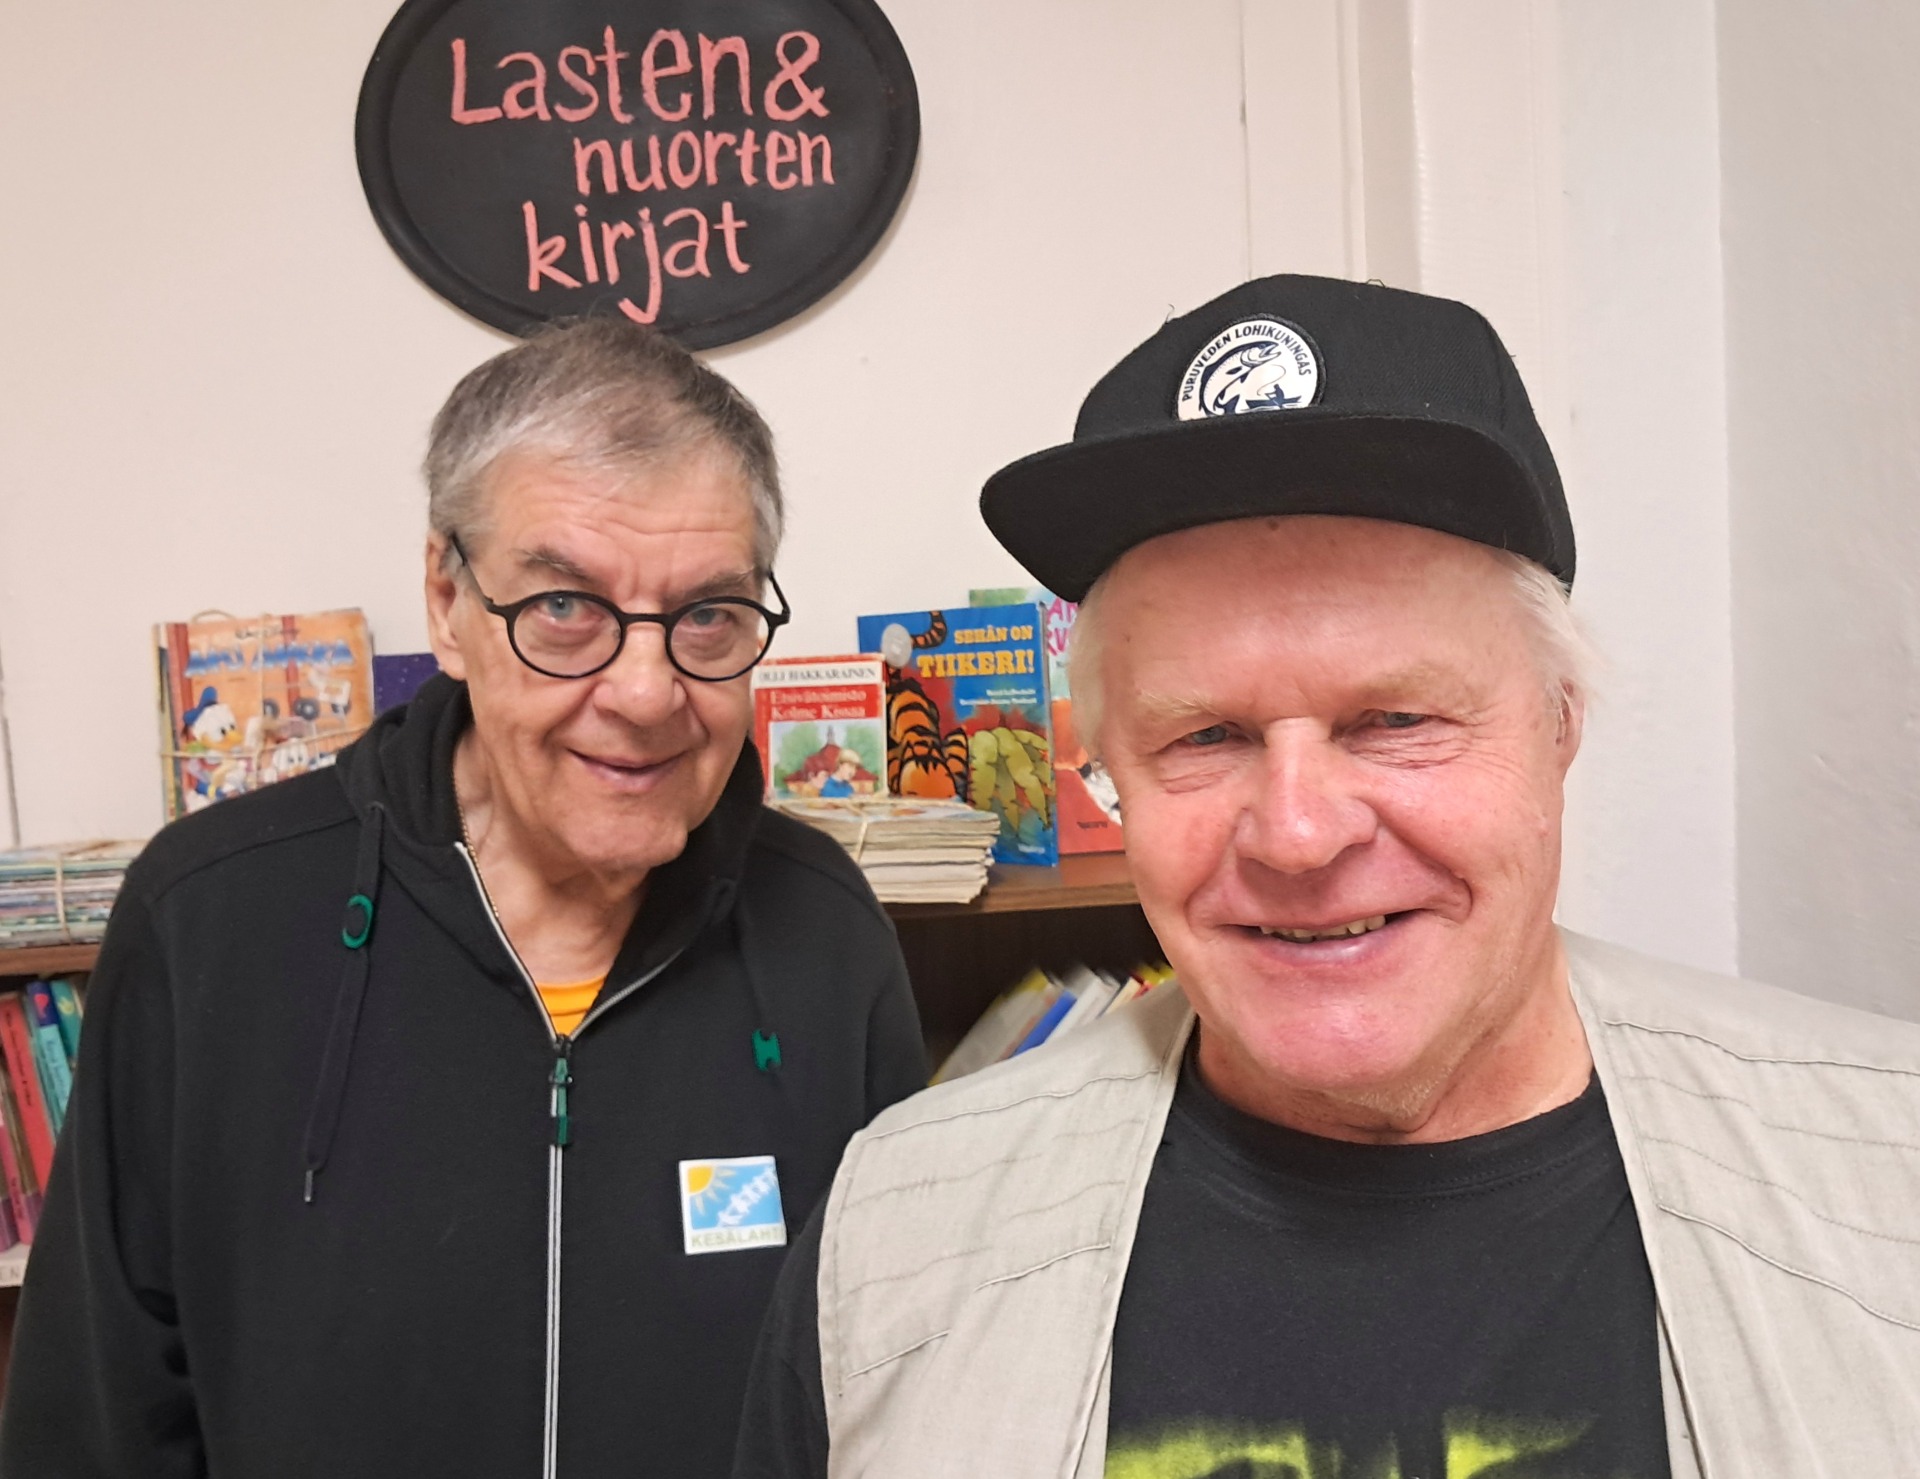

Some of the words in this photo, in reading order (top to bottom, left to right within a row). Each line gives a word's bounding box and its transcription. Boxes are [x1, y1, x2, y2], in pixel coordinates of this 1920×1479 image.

[450, 25, 754, 125] Lasten
[764, 30, 831, 122] &
[573, 127, 835, 197] nuorten
[522, 200, 750, 324] kirjat
[1181, 333, 1232, 402] PURUVEDEN
[1235, 324, 1312, 376] LOHIKUNINGAS
[916, 649, 1035, 678] TIIKERI!
[1010, 625, 1033, 640] ON
[787, 668, 876, 680] HAKKARAINEN
